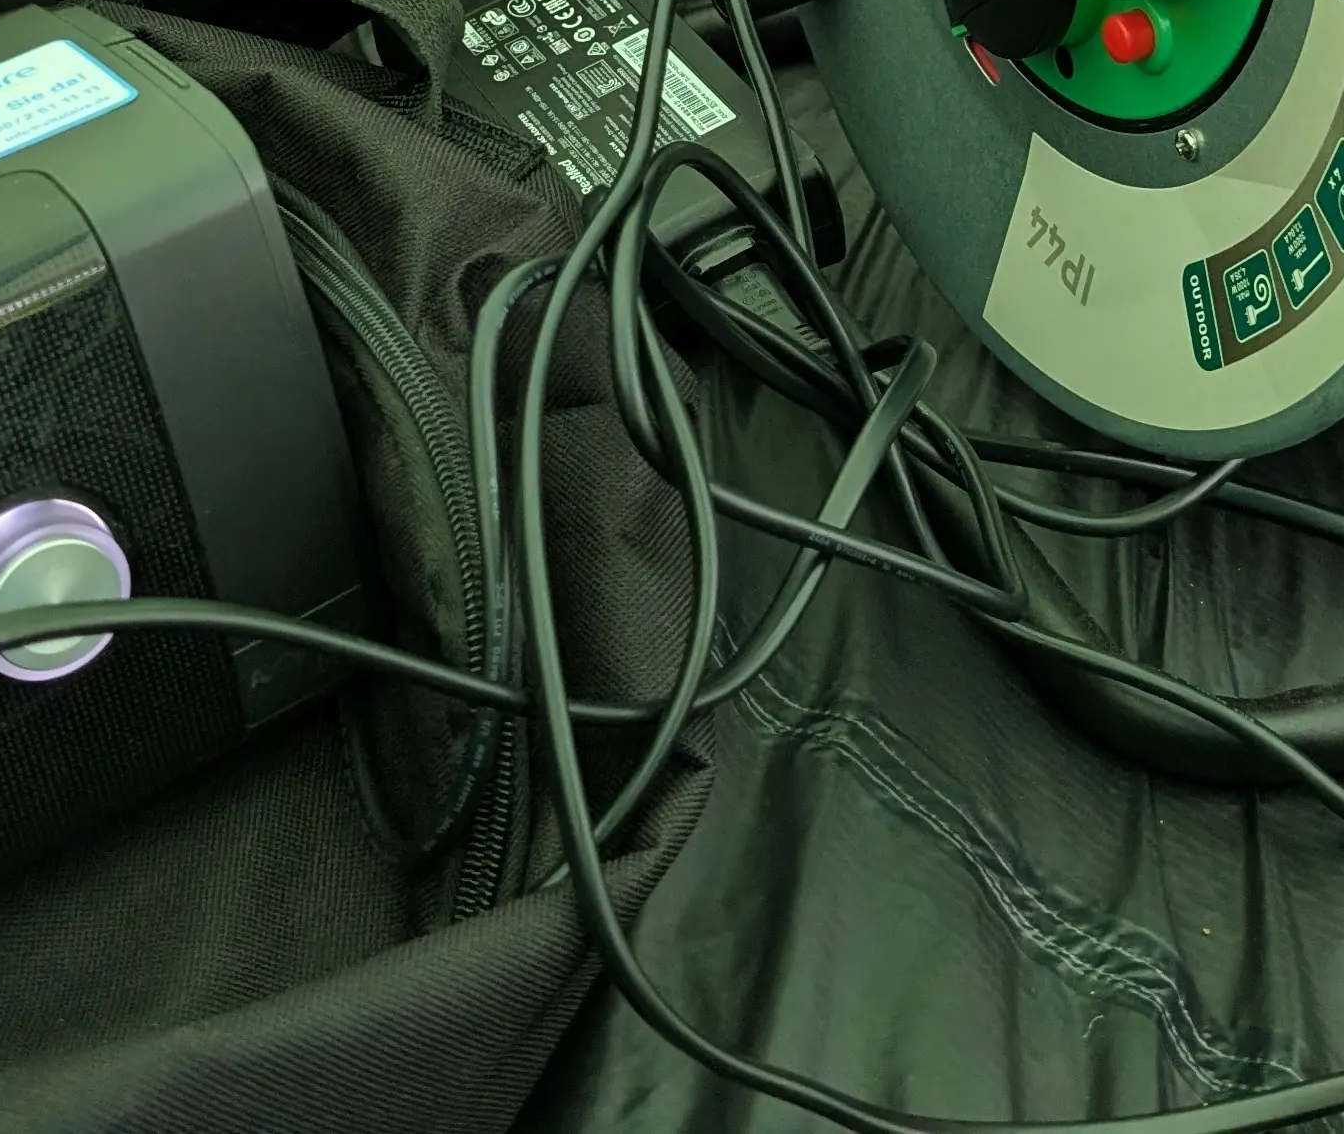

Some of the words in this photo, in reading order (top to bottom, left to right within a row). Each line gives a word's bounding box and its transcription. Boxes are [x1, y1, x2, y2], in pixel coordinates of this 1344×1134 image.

[6, 90, 44, 111] Sie
[24, 111, 34, 122] 2
[516, 112, 541, 136] ADAPTER
[556, 157, 595, 192] ResMed
[1333, 168, 1341, 181] 4
[1026, 206, 1095, 306] IP44
[1189, 274, 1212, 361] OUTDOOR
